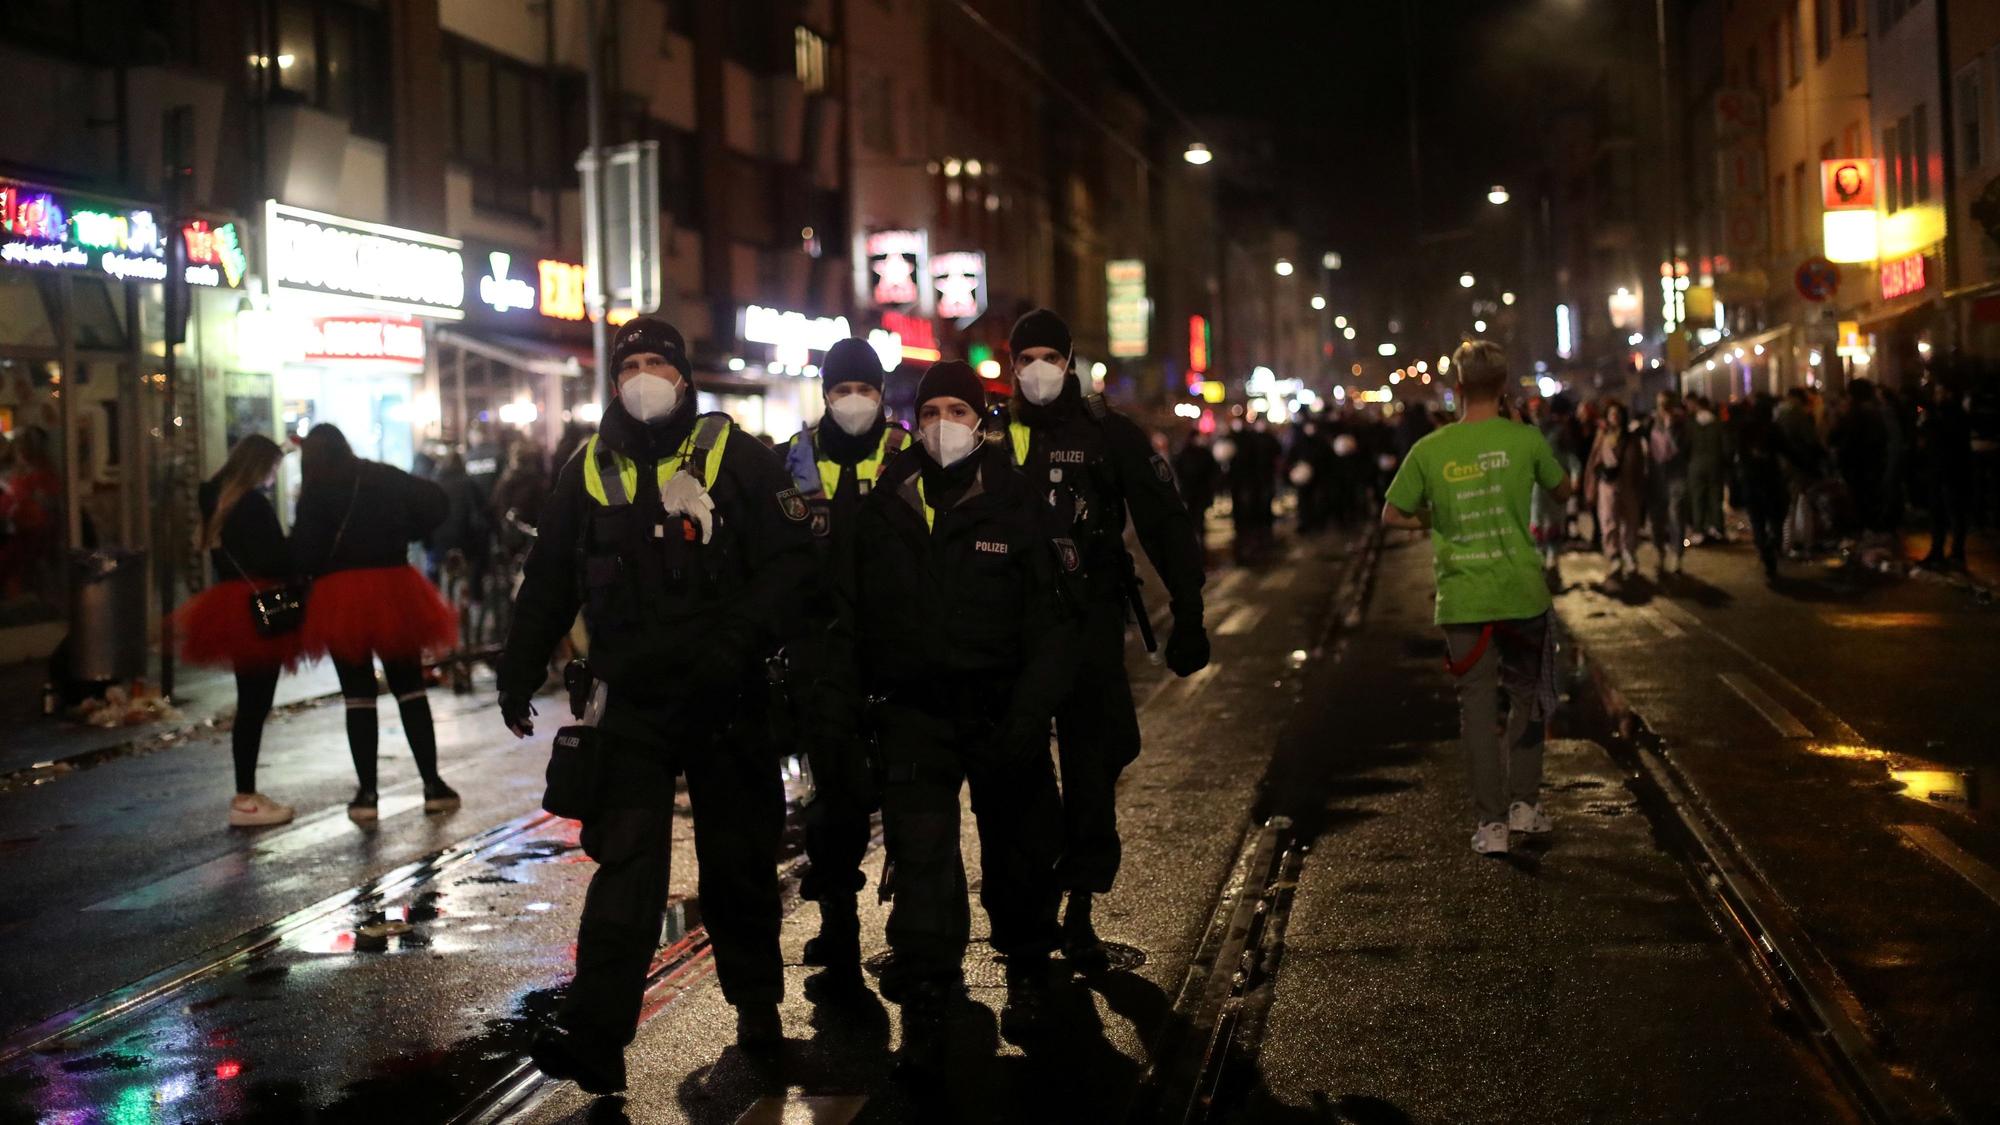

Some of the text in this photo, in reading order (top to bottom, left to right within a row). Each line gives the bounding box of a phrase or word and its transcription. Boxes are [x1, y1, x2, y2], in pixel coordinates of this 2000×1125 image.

[1050, 450, 1084, 463] POLIZEI
[976, 541, 1008, 554] POLIZEI
[558, 736, 580, 748] POLIZEI
